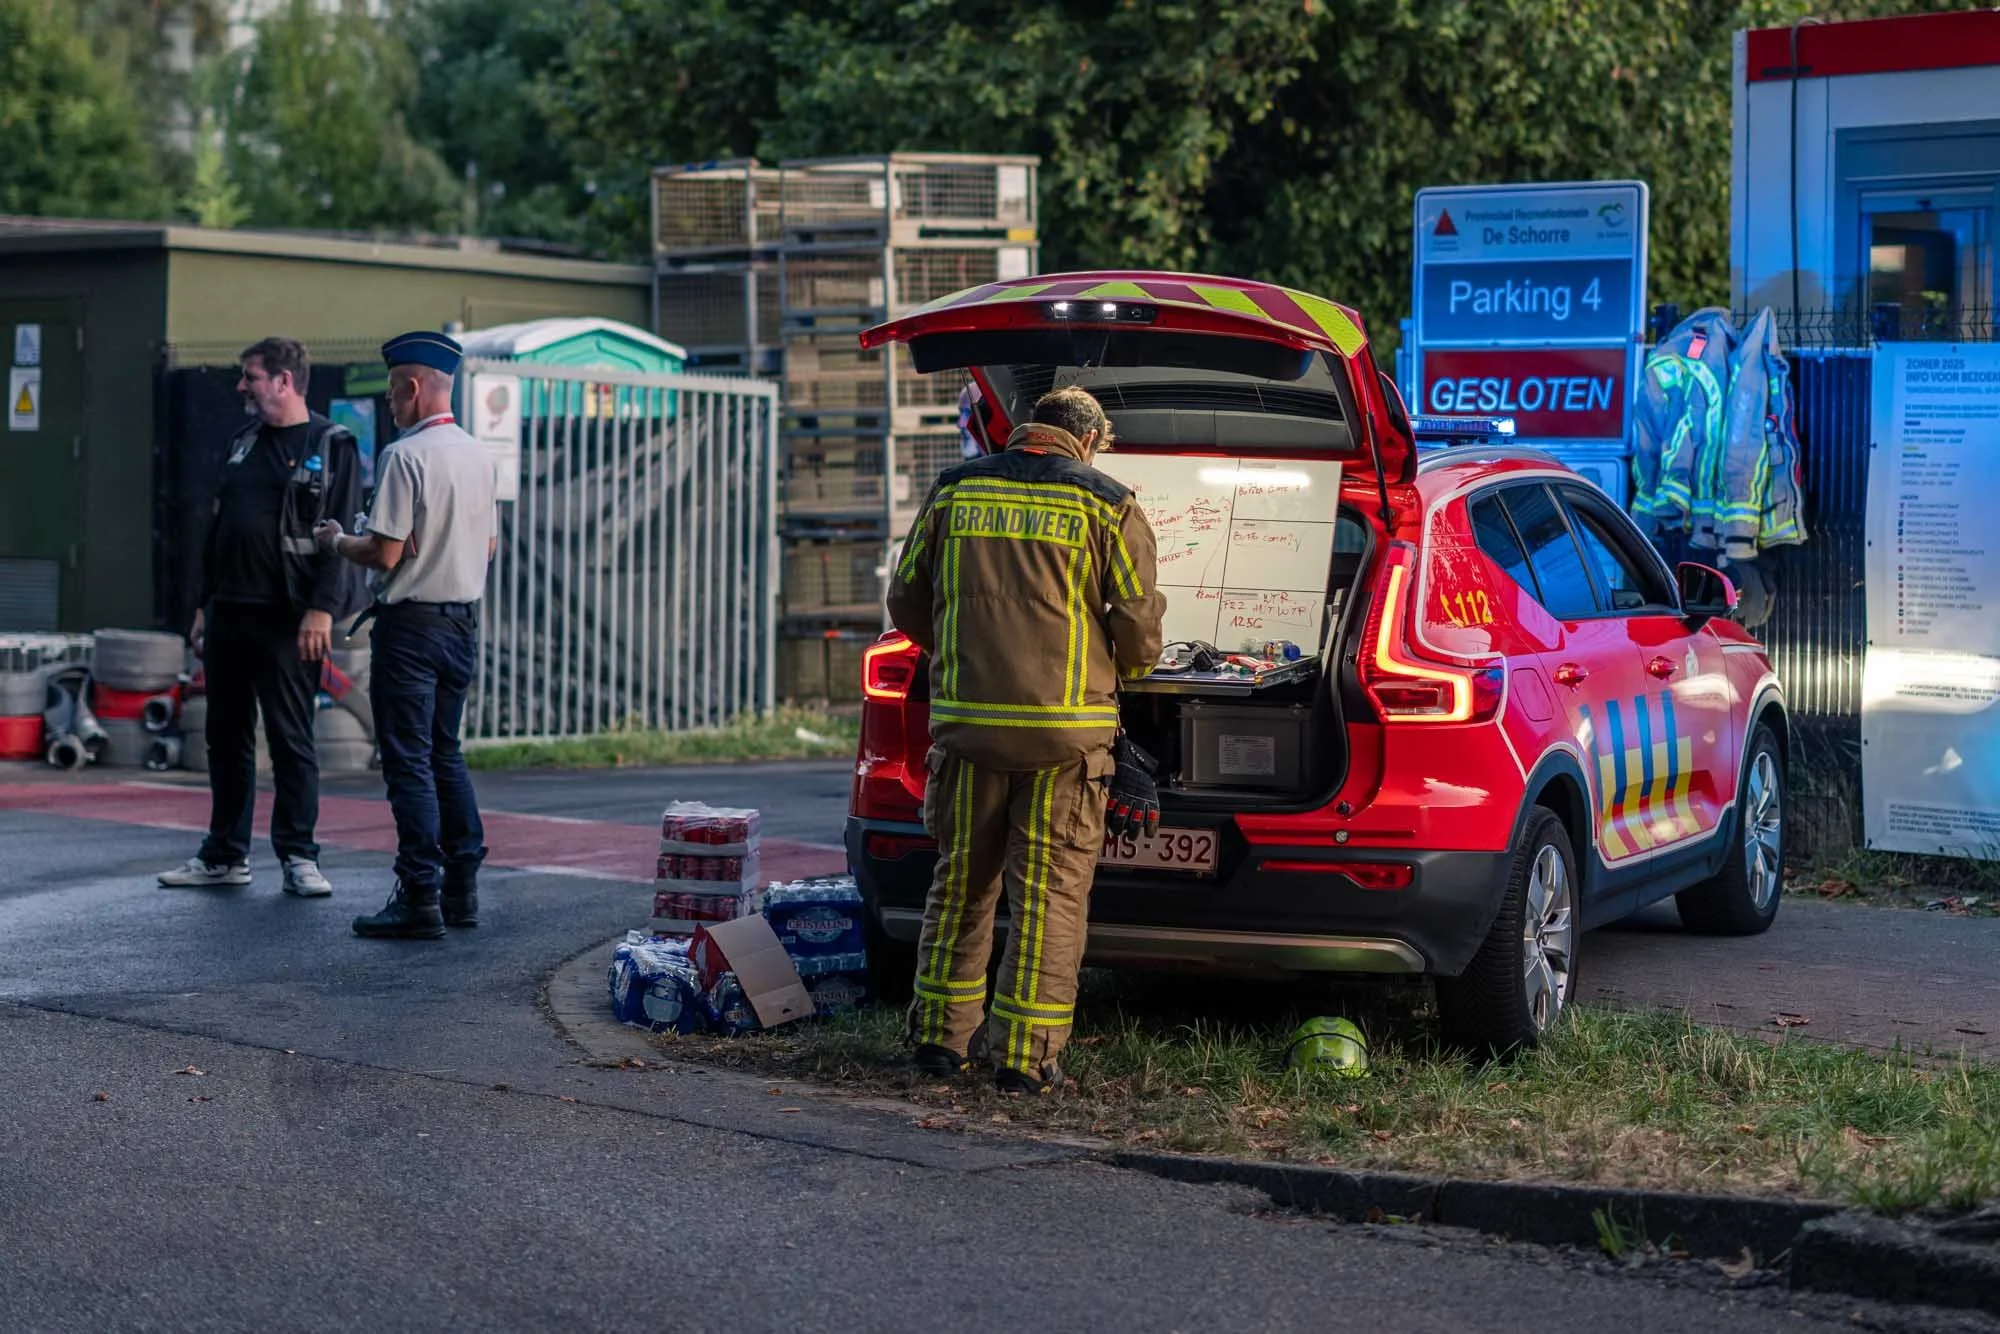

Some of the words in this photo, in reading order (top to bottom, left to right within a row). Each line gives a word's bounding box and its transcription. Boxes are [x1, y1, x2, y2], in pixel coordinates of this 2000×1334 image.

[1483, 227, 1504, 245] De
[1508, 225, 1571, 245] Schorre
[1450, 279, 1571, 321] Parking
[1581, 277, 1602, 312] 4
[1905, 358, 1941, 370] ZOMER
[1942, 358, 1966, 370] 2025
[1905, 371, 1929, 383] INFO
[1931, 371, 1960, 383] VOOR
[1961, 371, 2000, 384] BEZOEK
[1430, 376, 1615, 412] GESLOTEN
[953, 504, 1085, 543] BRANDWEER
[1454, 589, 1495, 628] 112
